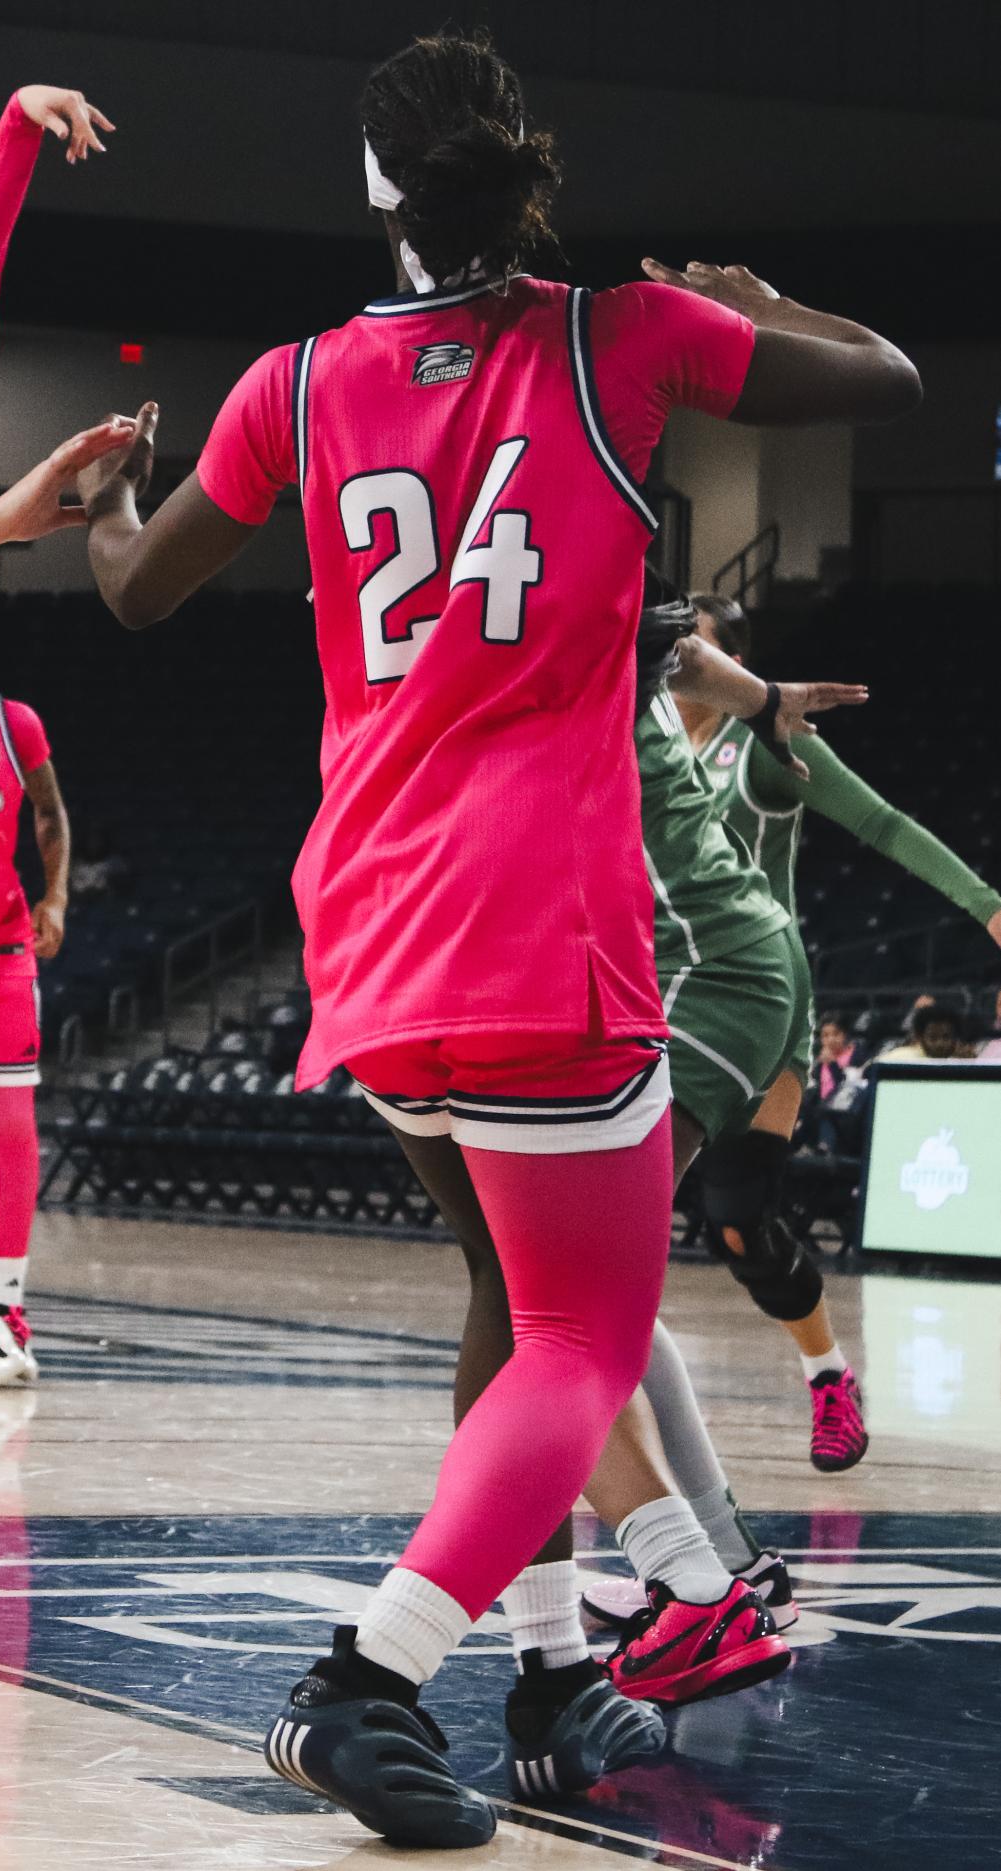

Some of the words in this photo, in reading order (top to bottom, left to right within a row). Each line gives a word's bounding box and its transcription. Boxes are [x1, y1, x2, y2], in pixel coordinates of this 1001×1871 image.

[420, 369, 469, 385] SOUTHERN
[423, 362, 471, 377] GEORGIA
[339, 436, 543, 685] 24
